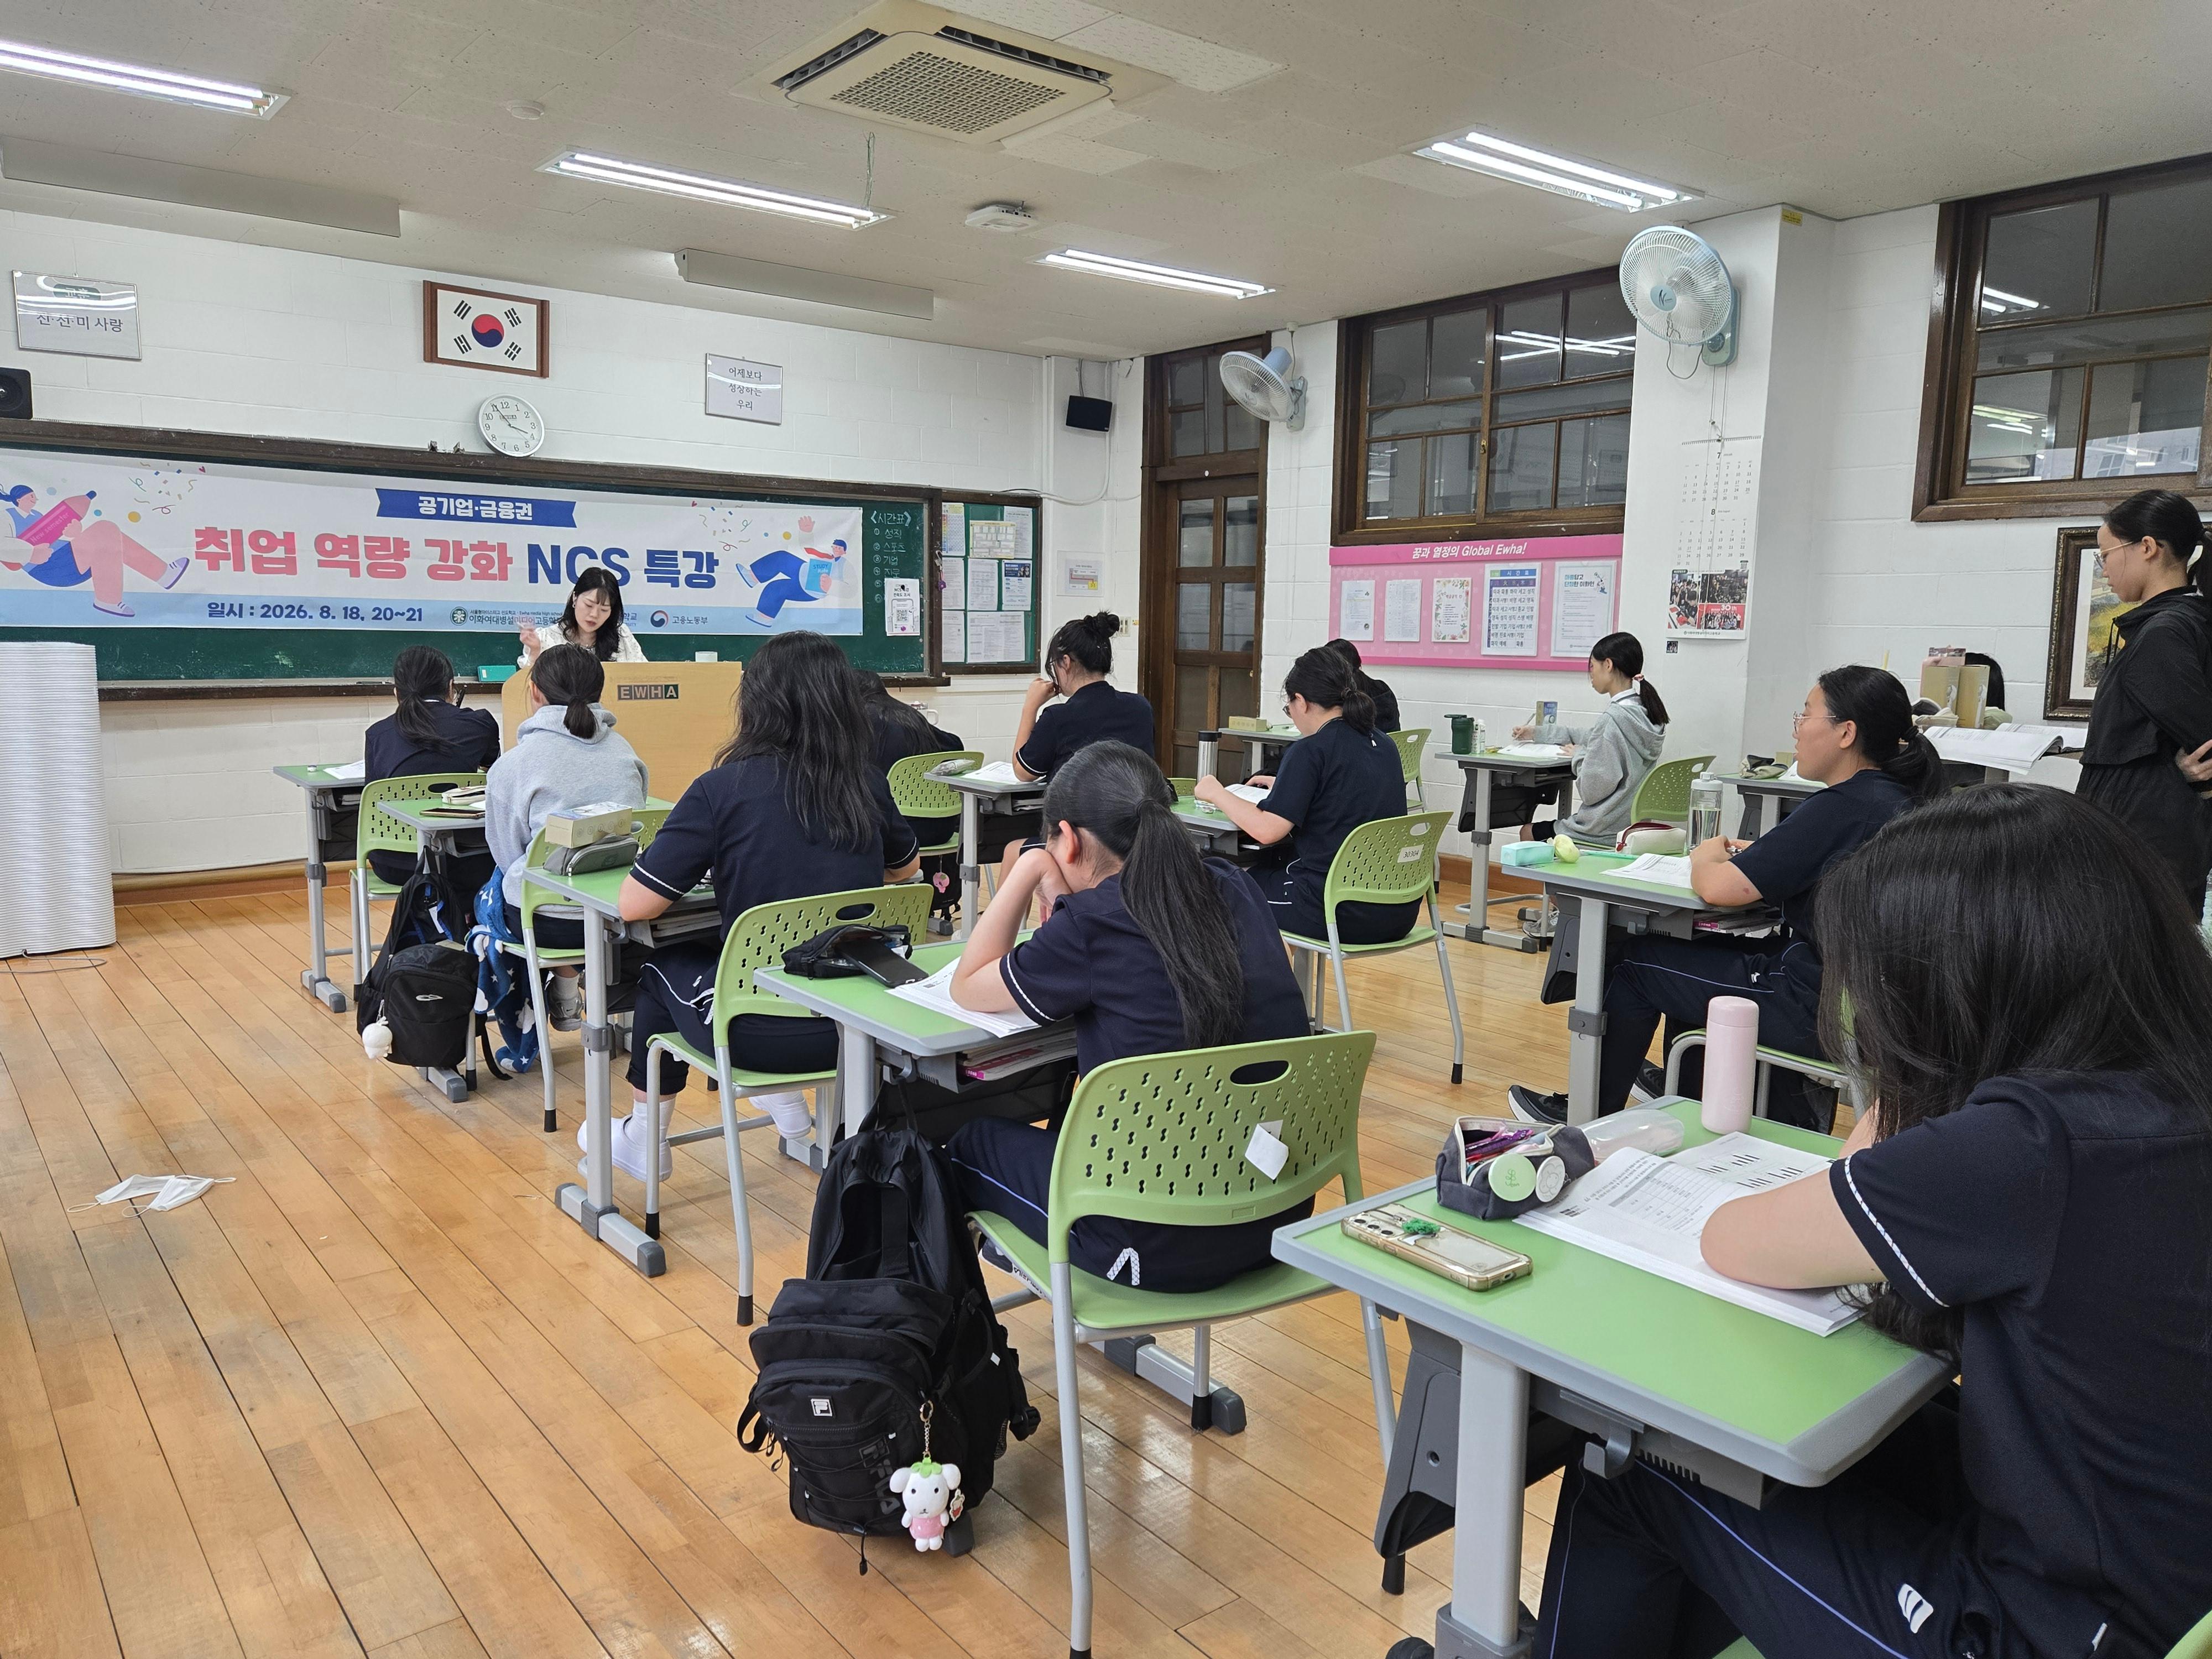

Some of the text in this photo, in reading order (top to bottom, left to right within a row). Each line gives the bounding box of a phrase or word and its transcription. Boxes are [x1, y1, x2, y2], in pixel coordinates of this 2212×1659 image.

[94, 317, 123, 333] 사랑
[728, 367, 763, 381] 어제보다
[728, 383, 763, 397] 성장하는
[736, 399, 753, 411] 우리
[418, 495, 533, 521] 공기업·금융권
[885, 529, 902, 539] 성직
[884, 542, 906, 554] 스포츠
[1412, 542, 1527, 559] 꿈과 열정의 Global Ewha!
[195, 526, 719, 589] 취업 역량 강화 NCS 특강
[884, 555, 898, 565] 기업
[207, 602, 423, 622] 일시 : 2026. 8. 18, 20~21
[672, 615, 708, 625] 고용노동부
[620, 686, 677, 698] EWHA
[1403, 849, 1420, 858] 30304
